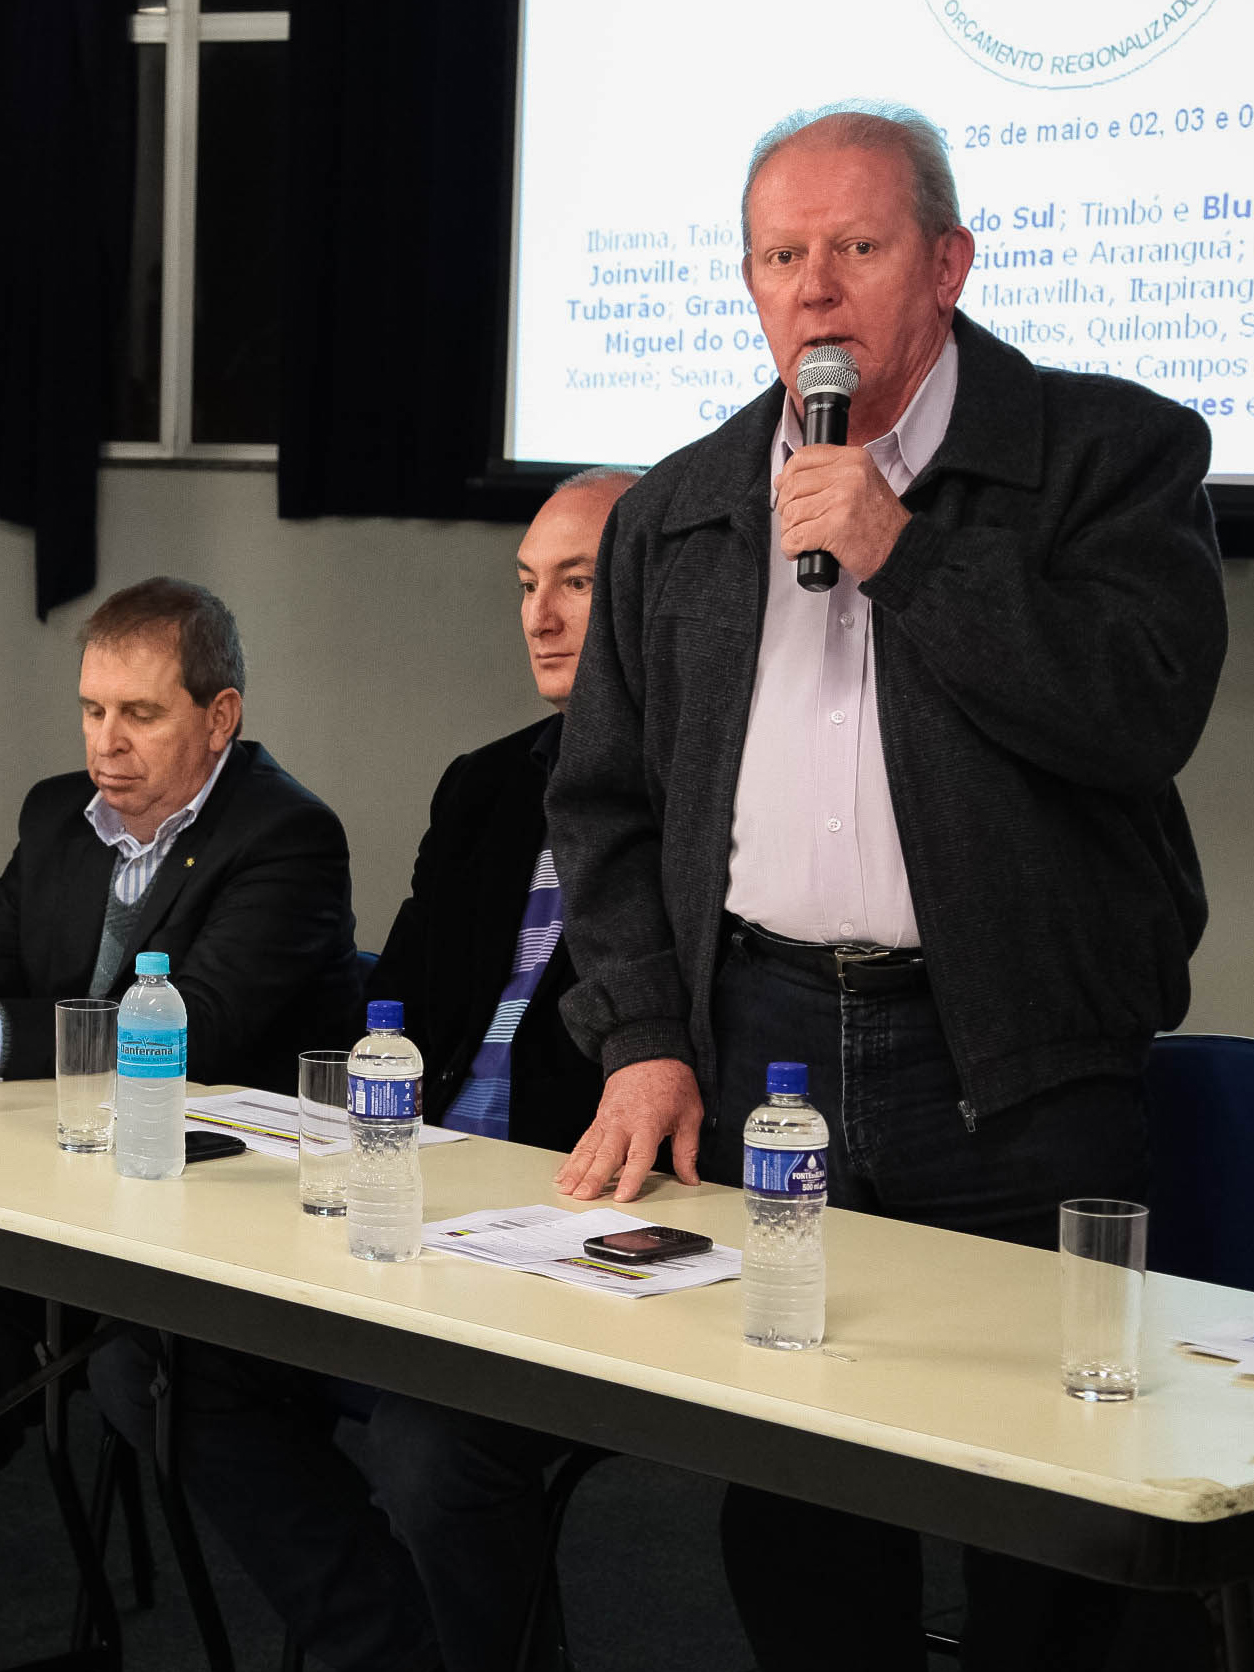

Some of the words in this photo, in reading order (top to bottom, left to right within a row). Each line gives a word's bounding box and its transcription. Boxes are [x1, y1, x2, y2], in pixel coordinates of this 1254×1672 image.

[964, 125, 991, 149] 26
[1000, 122, 1027, 146] de
[1037, 117, 1099, 143] maio
[1108, 120, 1121, 138] e
[1175, 107, 1205, 133] 03
[1215, 111, 1229, 130] e
[969, 208, 1001, 232] do
[1082, 195, 1163, 226] Timbó
[1173, 203, 1190, 222] e
[1063, 248, 1077, 266] e
[1089, 230, 1244, 267] Araranguá;
[605, 328, 683, 358] Miguel
[694, 328, 723, 351] do
[1088, 312, 1228, 347] Quilombo,
[1136, 354, 1247, 383] Campos
[121, 1044, 173, 1056] Danferrana
